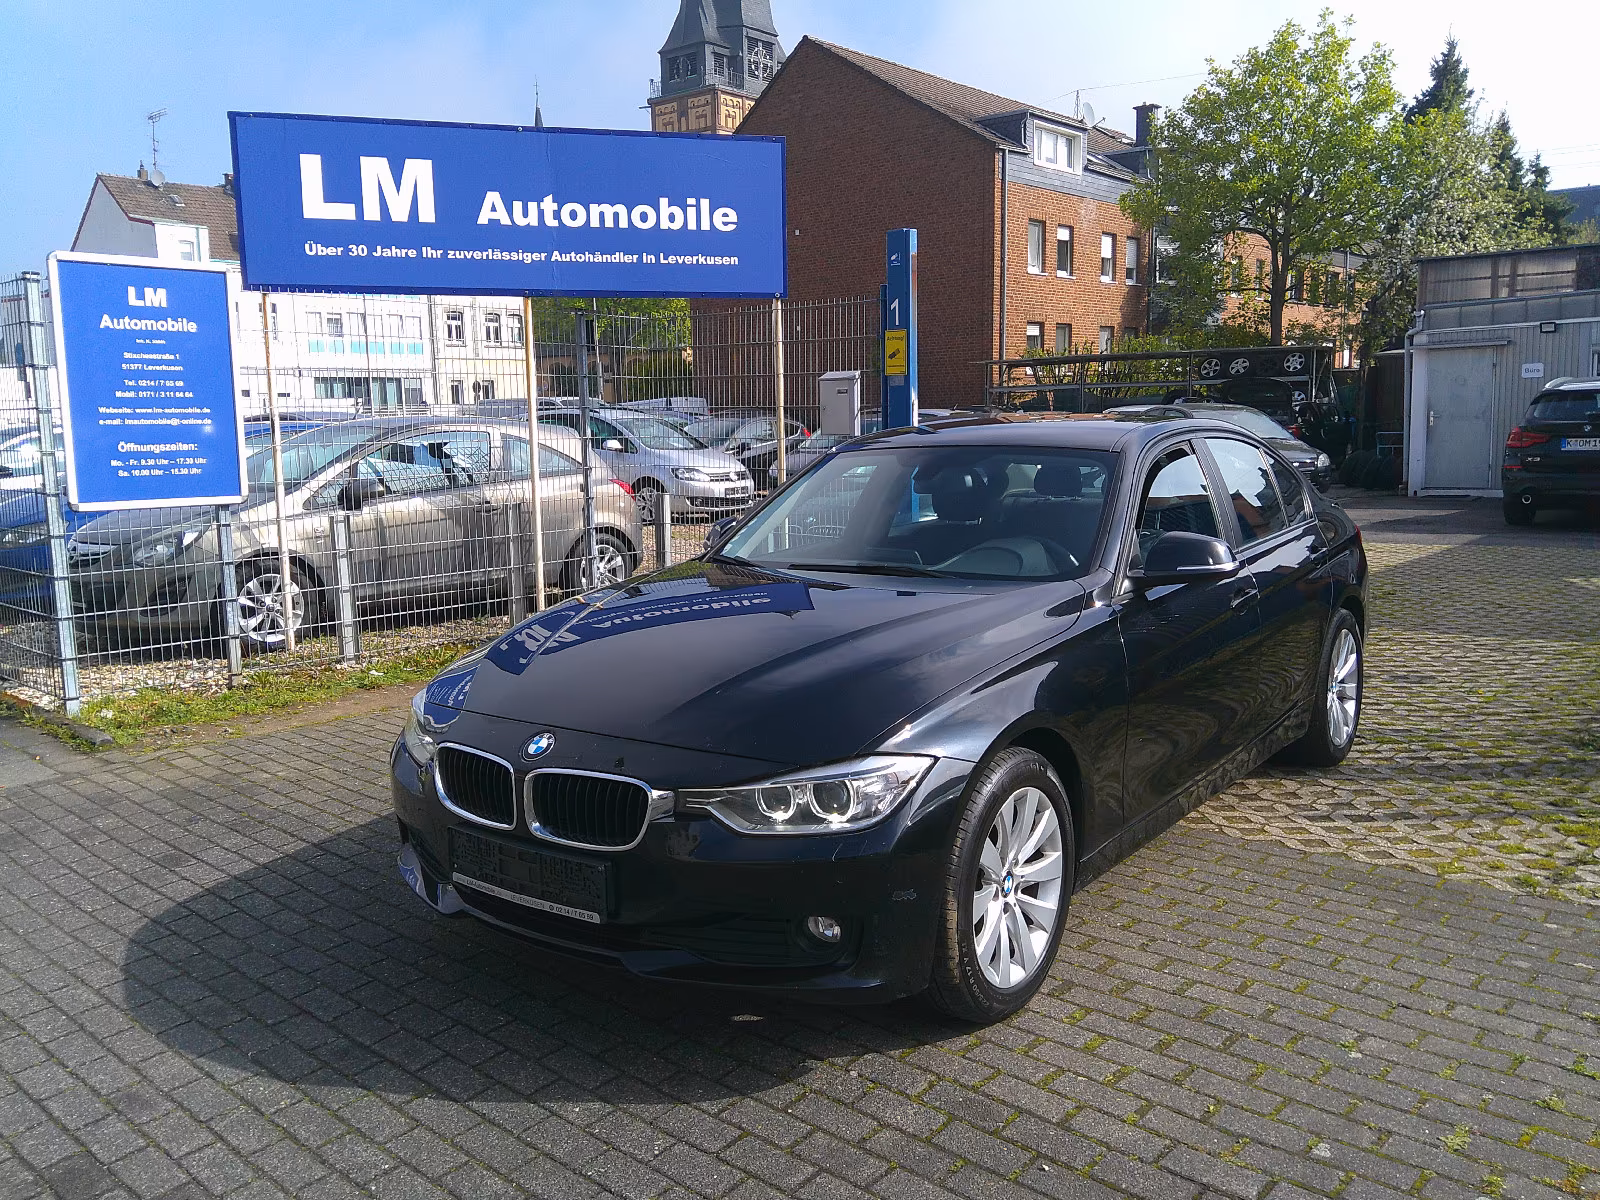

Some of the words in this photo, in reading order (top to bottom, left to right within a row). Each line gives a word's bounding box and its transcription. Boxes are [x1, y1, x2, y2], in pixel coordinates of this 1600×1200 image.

[299, 152, 436, 224] LM
[477, 190, 738, 232] Automobile
[304, 241, 344, 256] Über
[348, 244, 368, 257] 30
[372, 245, 417, 258] Jahre
[421, 246, 444, 259] Ihr
[447, 248, 548, 264] zuverlässiger
[550, 250, 639, 264] Autohändler
[659, 253, 739, 265] Leverkusen
[127, 285, 168, 308] LM
[890, 298, 900, 326] 1
[99, 313, 198, 333] Automobile
[121, 363, 143, 371] 51377
[143, 363, 184, 371] Leverkusen
[123, 379, 137, 387] Tel.
[138, 379, 155, 387] 0214
[115, 390, 138, 398] Mobil:
[97, 406, 134, 414] Webseite:
[117, 440, 199, 454] Öffnungszeiten:
[110, 459, 125, 467] Mo.
[129, 459, 140, 467] Fr.
[117, 469, 131, 477] Sa.
[150, 468, 164, 476] Uhr
[189, 467, 202, 475] Uhr
